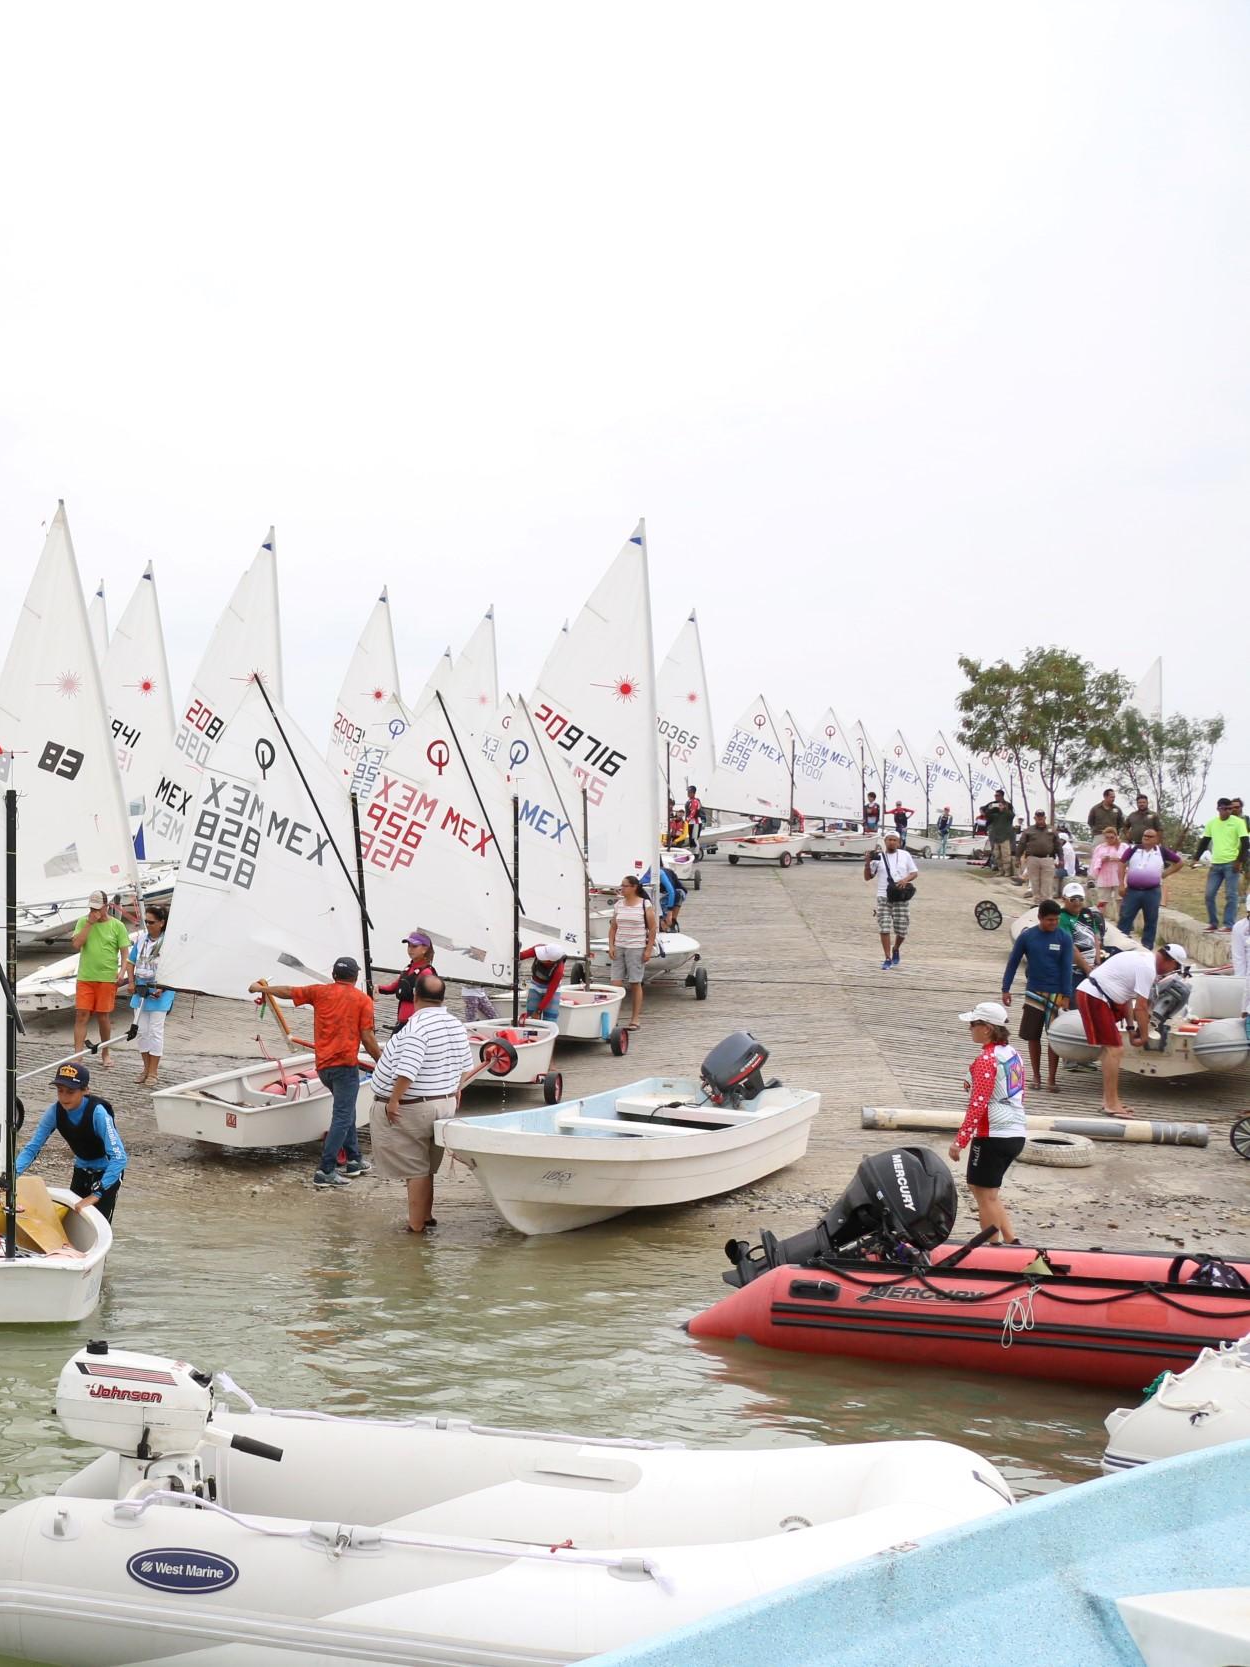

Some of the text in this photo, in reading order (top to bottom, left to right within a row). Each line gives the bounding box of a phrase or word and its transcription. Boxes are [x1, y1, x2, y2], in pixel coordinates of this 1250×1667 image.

[656, 716, 700, 750] 0365
[759, 741, 785, 765] MEX
[37, 740, 85, 781] 83
[830, 751, 855, 770] MEX
[154, 776, 193, 816] MEX
[194, 809, 261, 858] 828
[266, 811, 332, 866] MEX
[367, 802, 427, 849] 956
[440, 806, 495, 857] MEX
[518, 799, 570, 843] MEX
[891, 1154, 917, 1211] MERCURY
[89, 1384, 163, 1404] Johnson
[155, 1562, 224, 1579] West Marine
